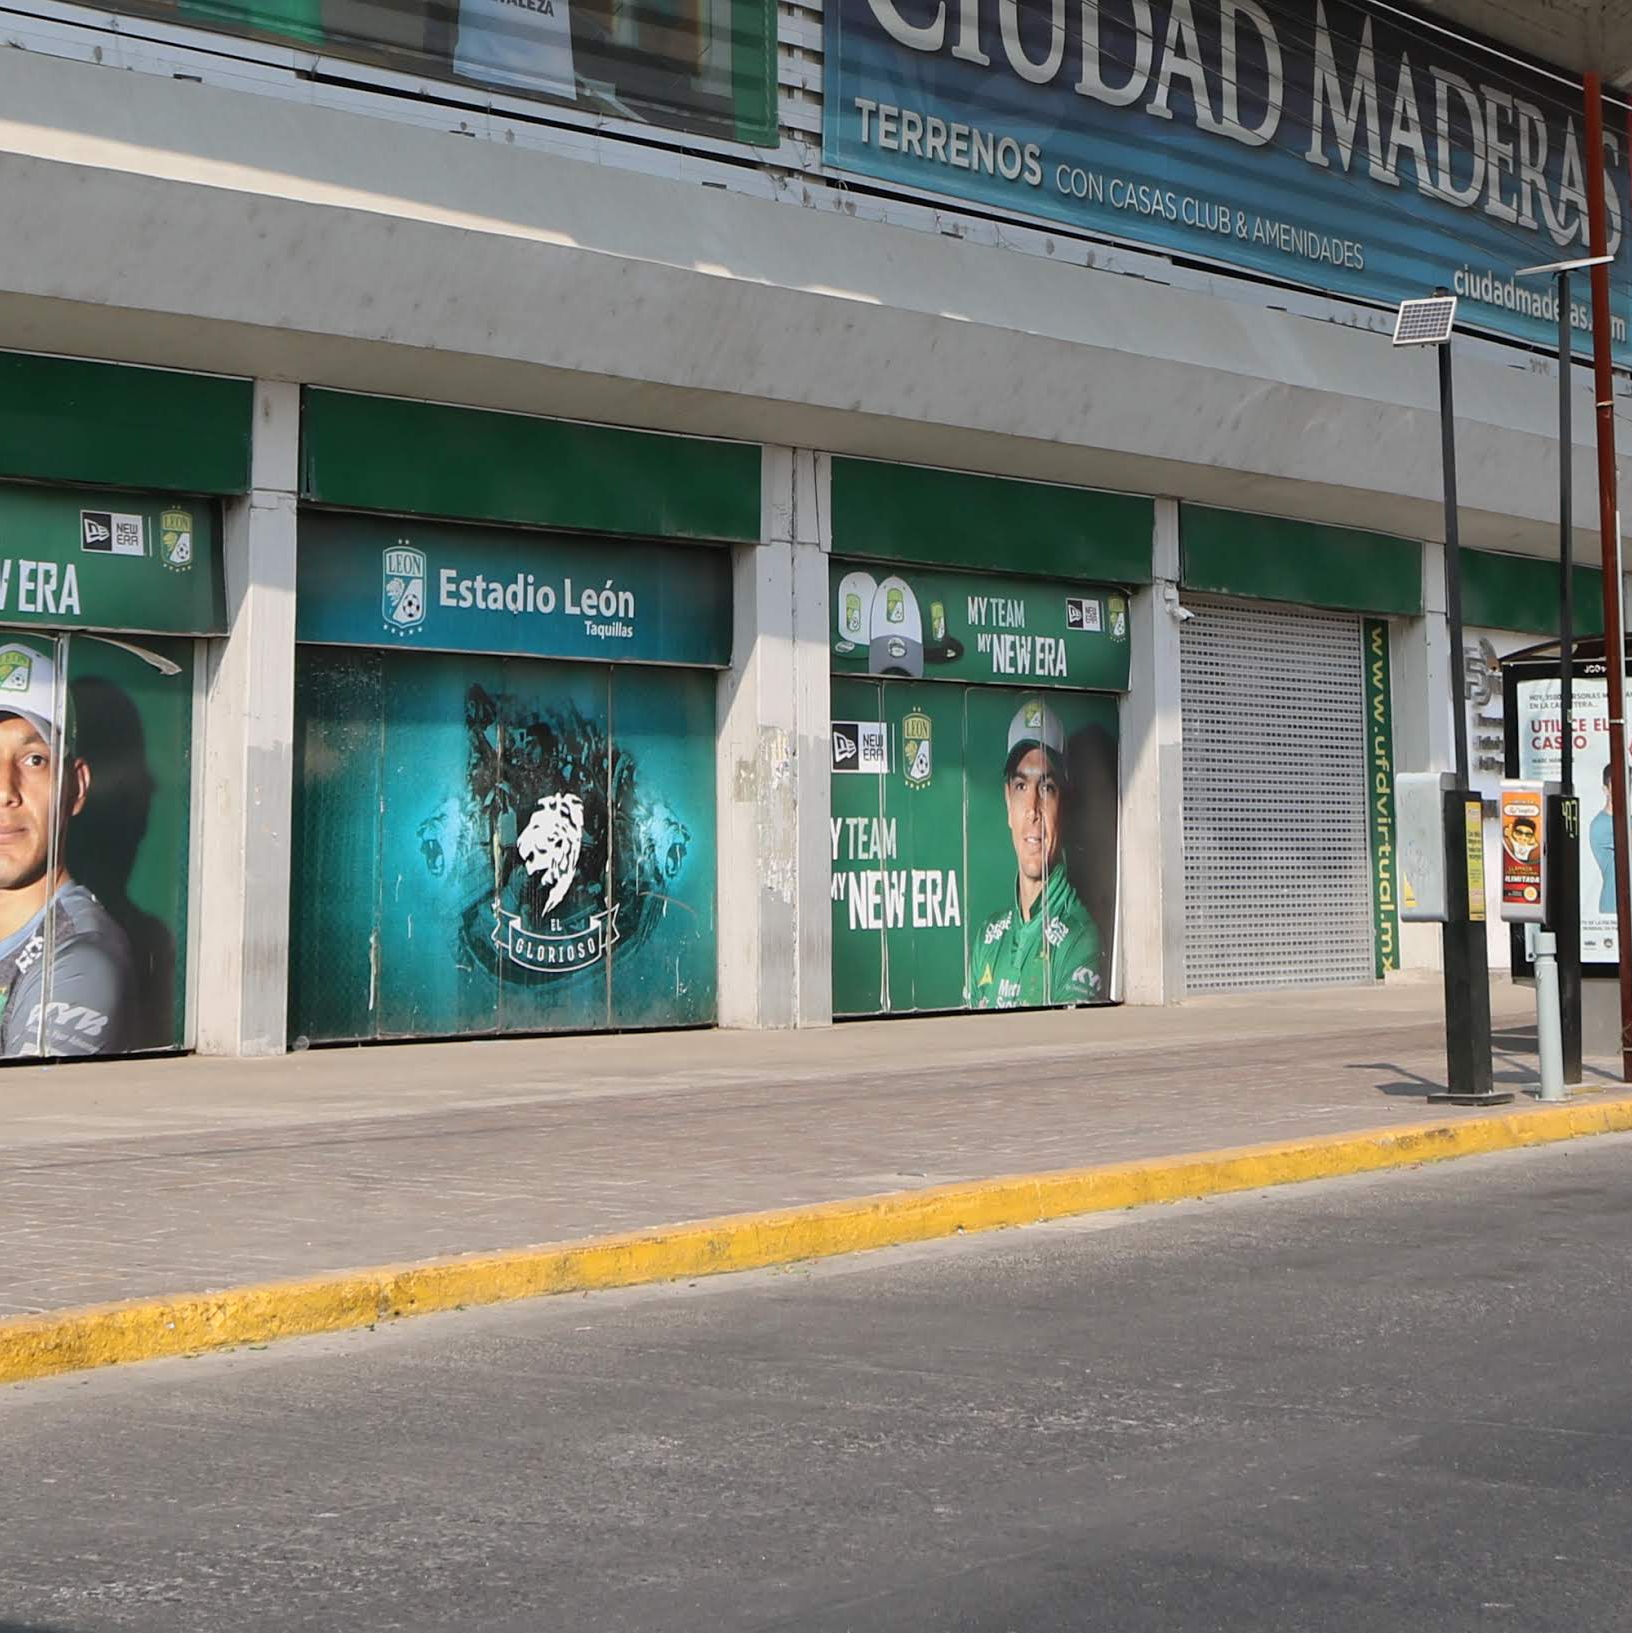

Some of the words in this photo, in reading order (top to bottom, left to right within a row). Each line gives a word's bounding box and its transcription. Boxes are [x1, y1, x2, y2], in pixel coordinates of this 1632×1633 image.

[855, 97, 1042, 186] TERRENOS
[1056, 164, 1103, 203] CON
[1110, 179, 1176, 220] CASAS
[1182, 197, 1231, 234] CLUB
[1236, 211, 1248, 239] &
[1253, 217, 1364, 270] AMENIDADES
[116, 521, 138, 535] NEW
[116, 533, 139, 546] ERA
[388, 552, 421, 575] LEON
[19, 559, 81, 615] ERA
[440, 568, 556, 615] Estadio
[564, 578, 635, 618] León
[967, 596, 988, 625] MY
[989, 598, 1025, 628] TEAM
[584, 620, 633, 640] Taquillas
[977, 633, 991, 654] MY
[992, 633, 1031, 675] NEW
[1035, 635, 1067, 678] ERA
[905, 717, 929, 738] LEON
[1593, 718, 1609, 732] EL
[863, 747, 884, 761] ERA
[1531, 735, 1588, 750] CASO
[1371, 626, 1396, 974] www.ufdvirtual.mx
[846, 817, 897, 860] TEAM
[847, 870, 908, 931] NEW
[911, 869, 961, 929] ERA
[550, 918, 562, 932] EL
[515, 936, 598, 964] GLORIOSO
